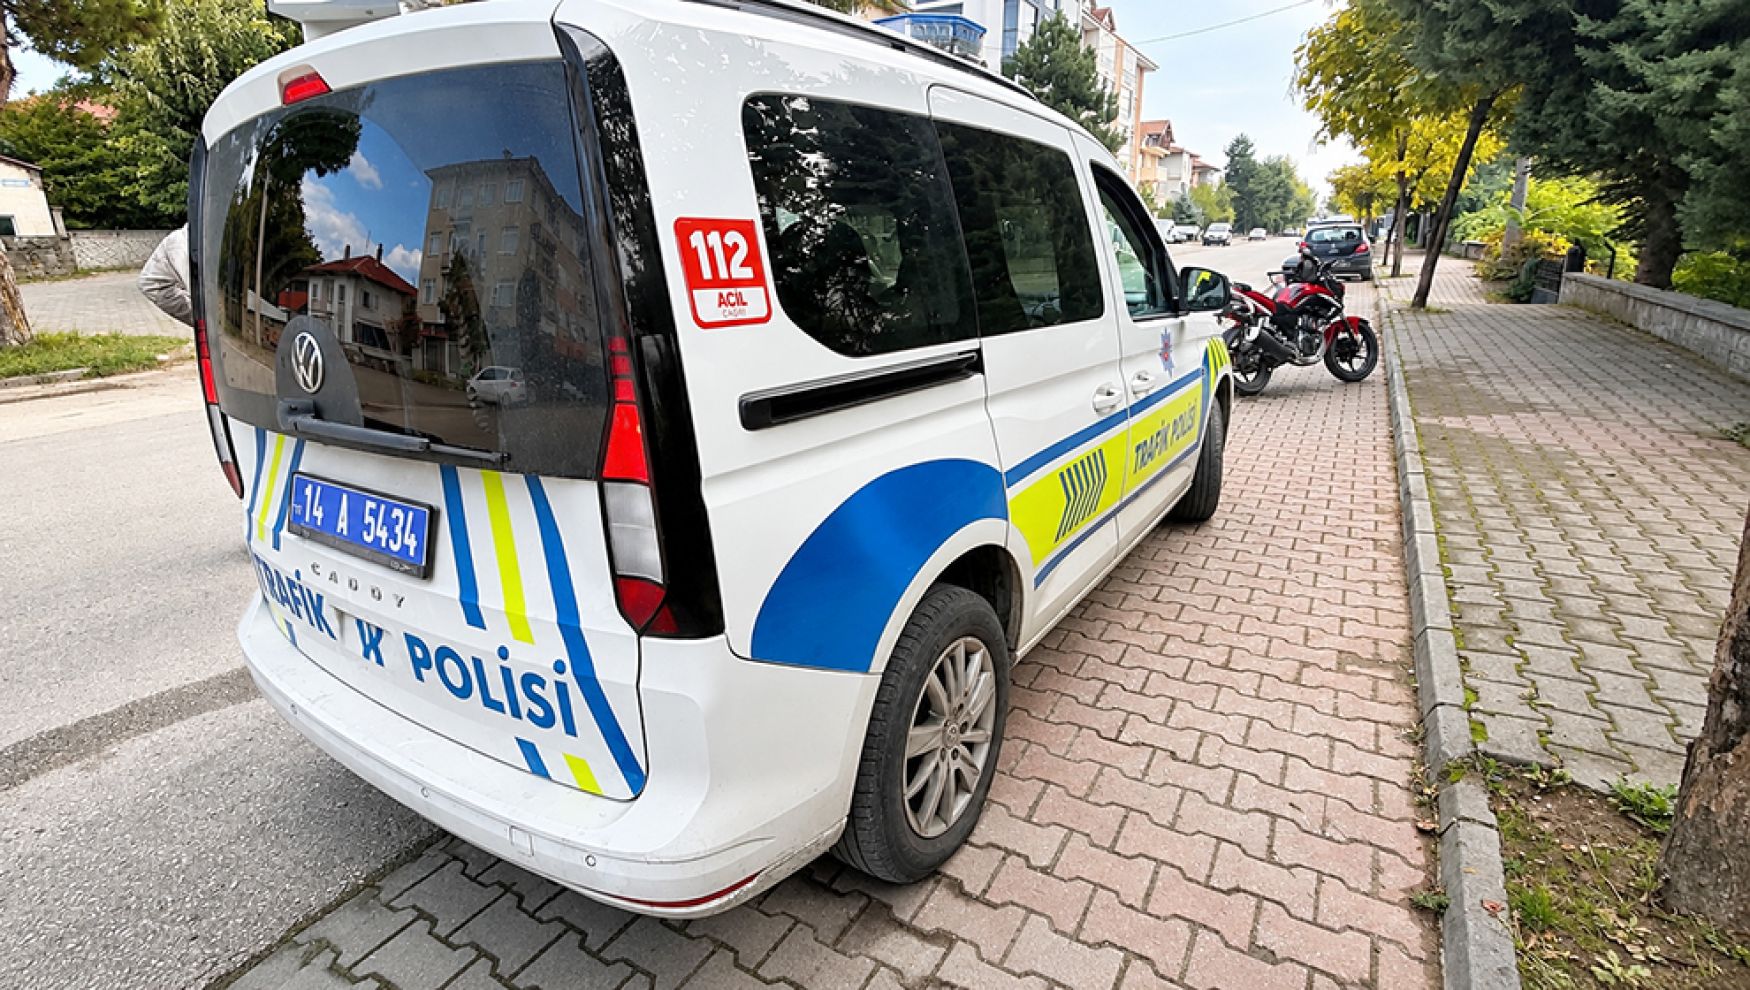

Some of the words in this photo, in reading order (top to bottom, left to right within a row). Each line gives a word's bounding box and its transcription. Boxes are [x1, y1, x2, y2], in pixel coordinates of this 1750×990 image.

[689, 230, 754, 280] 112
[304, 484, 324, 526] 14
[336, 493, 348, 537] A
[362, 500, 418, 558] 5434
[311, 561, 406, 608] CADDY
[403, 632, 578, 738] POLİSİ
